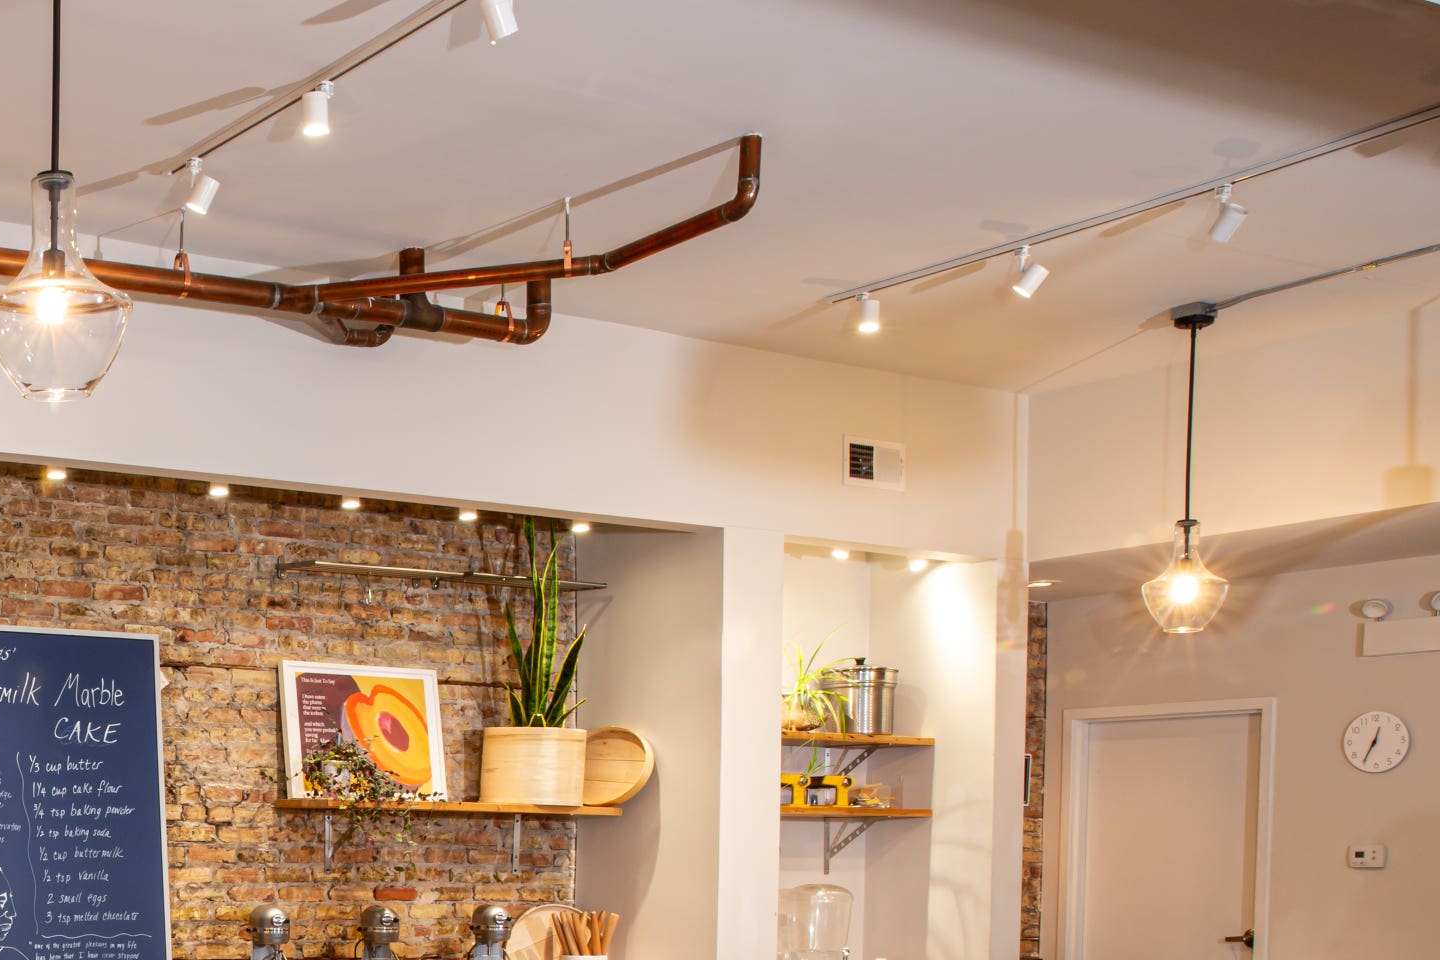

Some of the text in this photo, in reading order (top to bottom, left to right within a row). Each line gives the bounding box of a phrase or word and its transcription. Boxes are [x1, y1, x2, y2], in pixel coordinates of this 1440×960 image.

[54, 672, 125, 708] Marble
[54, 717, 121, 744] CAKE
[45, 762, 62, 774] cup
[66, 755, 103, 772] butter
[51, 786, 67, 798] cup
[72, 782, 93, 794] cake
[97, 780, 123, 797] flour
[50, 808, 65, 819] tsp
[70, 803, 102, 820] baking
[105, 805, 136, 818] powder
[48, 829, 60, 840] tsp
[64, 824, 90, 842] baking
[93, 828, 113, 839] soda
[53, 851, 68, 862] cup
[74, 845, 125, 859] buttermilk
[55, 872, 71, 885] tsp
[78, 869, 109, 882] vanilla
[47, 892, 108, 908] 2 small eggs
[45, 910, 140, 926] 3 tsp melted chocolate
